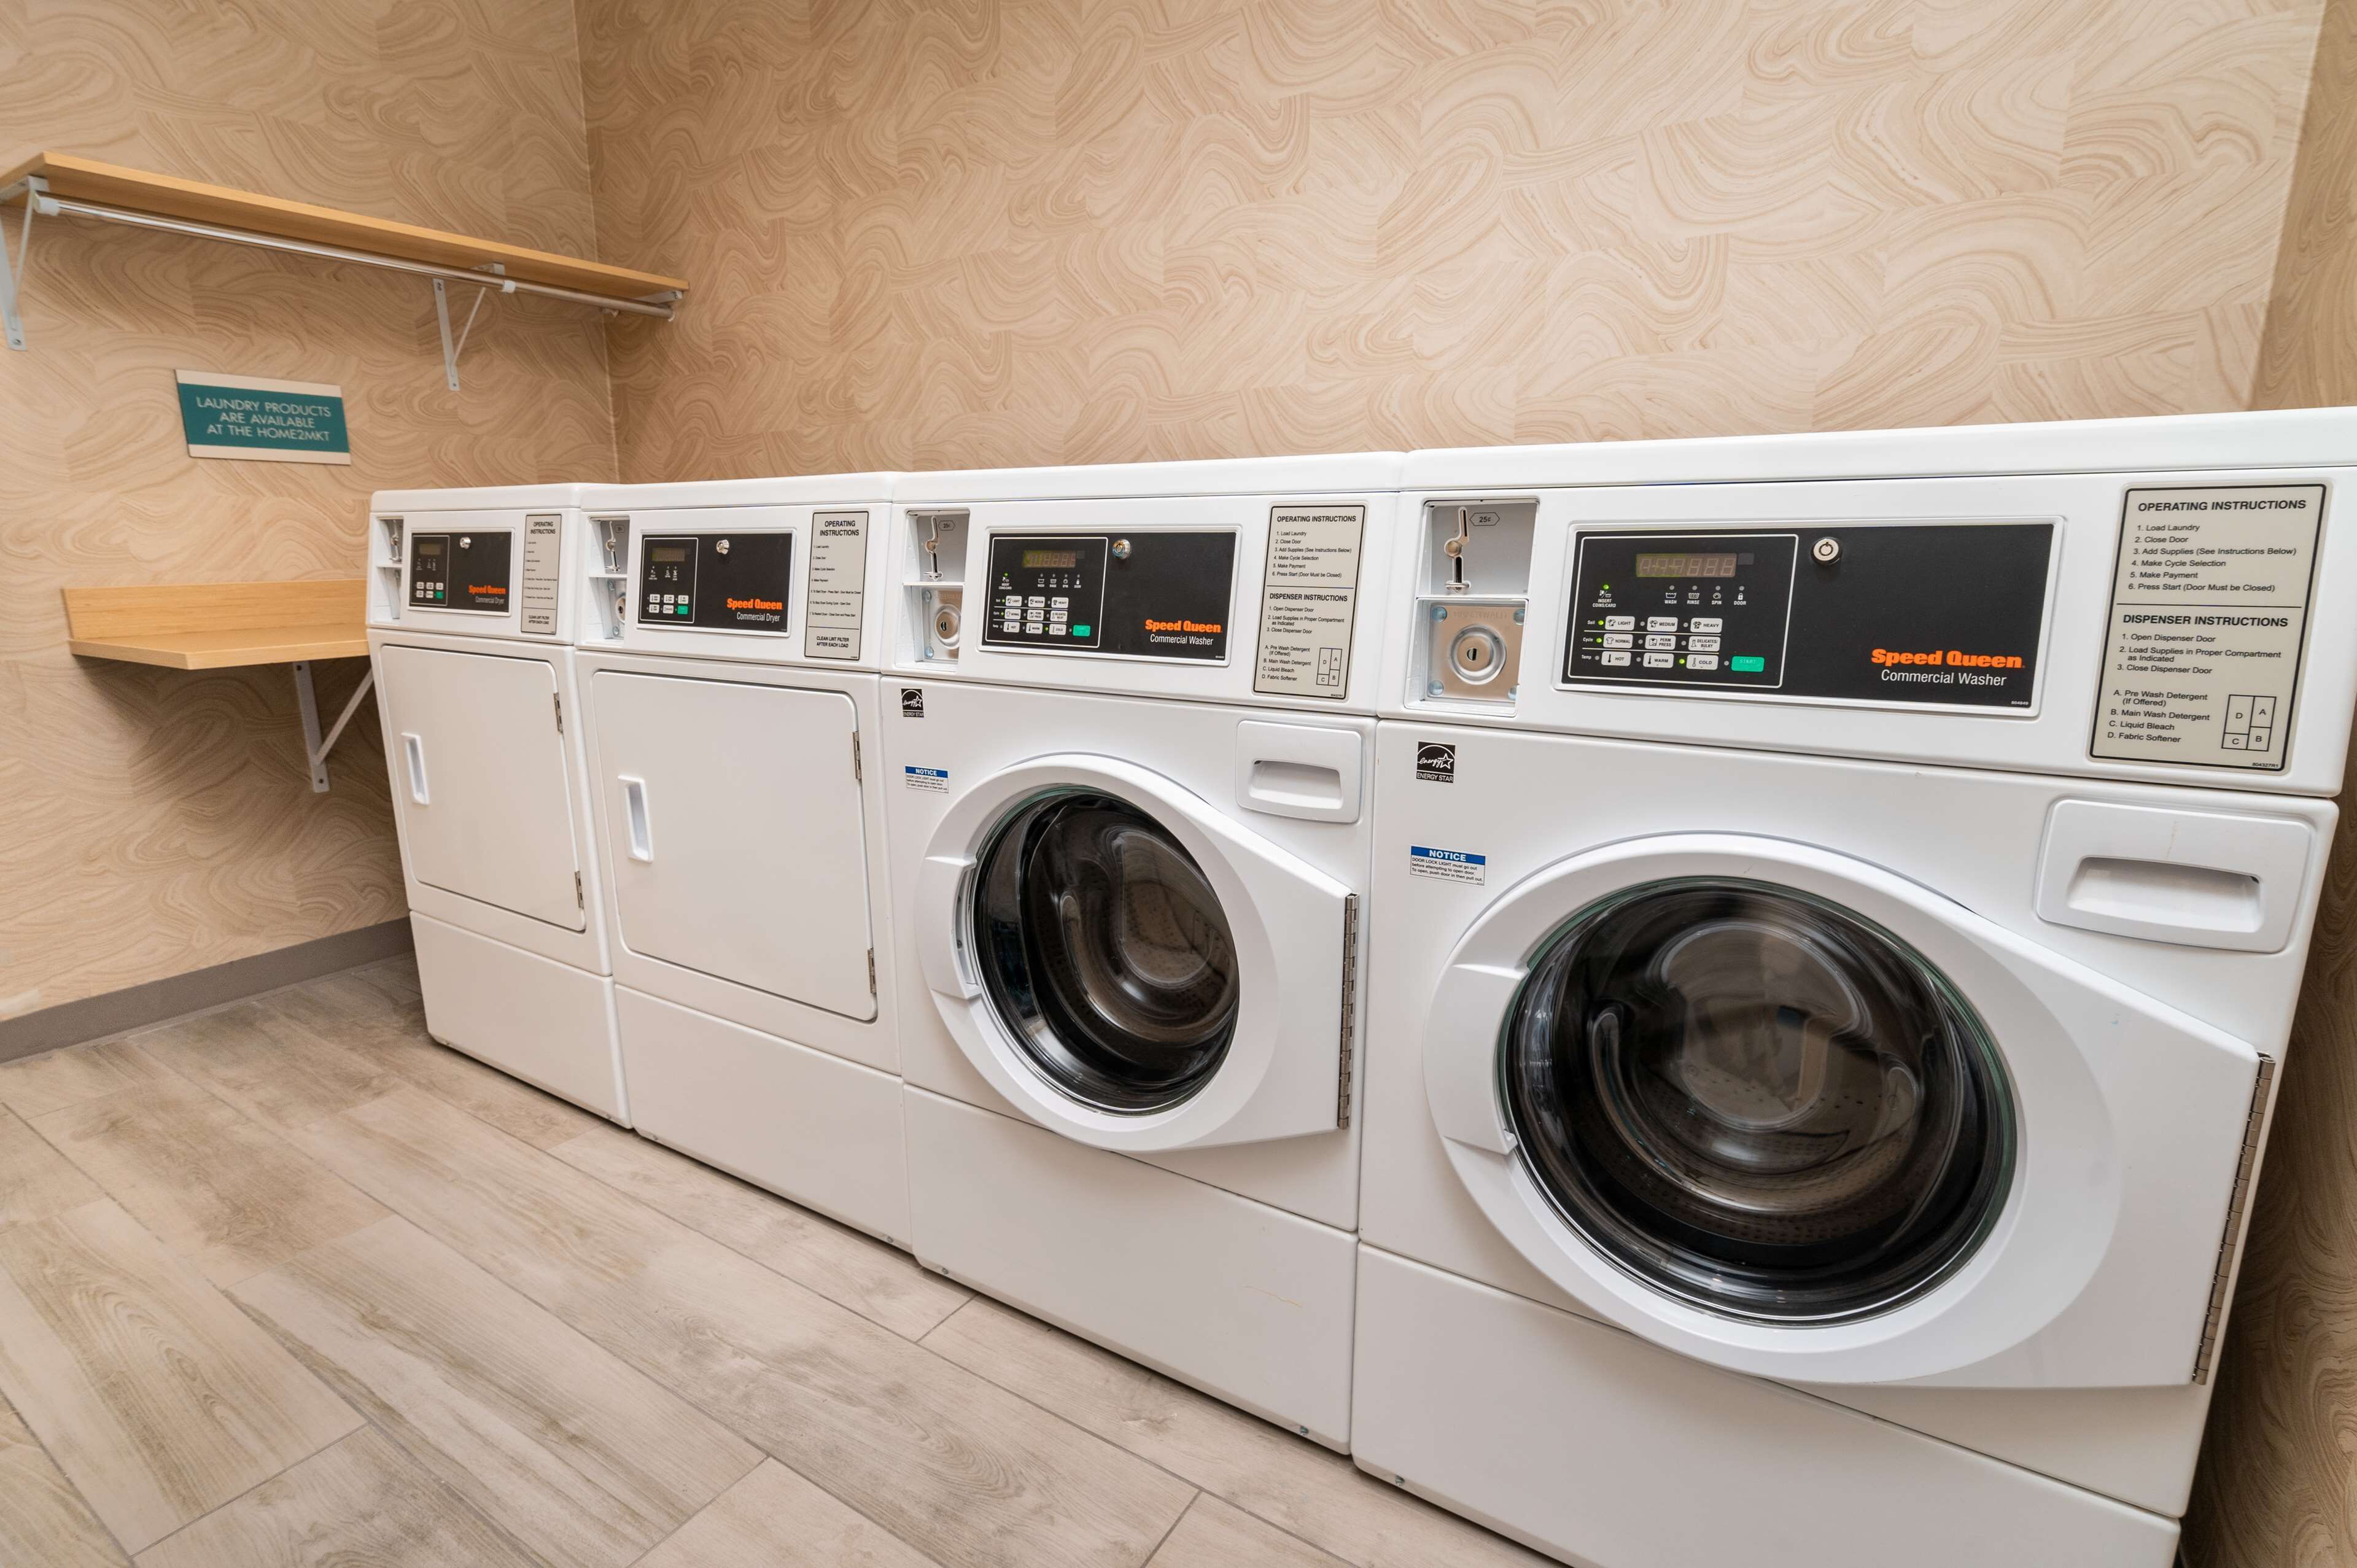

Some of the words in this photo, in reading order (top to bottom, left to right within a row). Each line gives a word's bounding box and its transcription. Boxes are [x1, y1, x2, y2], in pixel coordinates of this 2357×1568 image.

[196, 397, 260, 410] LAUNDRY
[265, 403, 331, 416] PRODUCTS
[220, 413, 245, 423] ARE
[250, 415, 315, 427] AVAILABLE
[208, 424, 223, 434] AT
[227, 425, 252, 437] THE
[257, 428, 329, 441] HOME2MKT
[2138, 502, 2208, 511] OPERATING
[2211, 500, 2306, 510] INSTRUCTIONS
[727, 599, 754, 610] Speed
[755, 599, 782, 610] Queen
[737, 612, 765, 621] Commercial
[766, 613, 780, 623] Dryer
[2123, 615, 2191, 624] DISPENSER
[2194, 616, 2288, 626] INSTRUCTIONS
[1145, 619, 1182, 632] Speed
[1183, 621, 1222, 632] Queen
[1150, 634, 1187, 643] Commercial
[1189, 636, 1213, 645] Washer
[2149, 647, 2184, 656] Supplies
[1871, 649, 1943, 666] Speed
[1946, 651, 2025, 667] Queen
[1881, 670, 1954, 683] Commercial
[1959, 673, 2007, 685] Washer
[2166, 692, 2208, 701] Detergent
[2133, 699, 2166, 707] Offered)
[2169, 712, 2210, 721] Detergent
[1429, 850, 1466, 861] NOTICE
